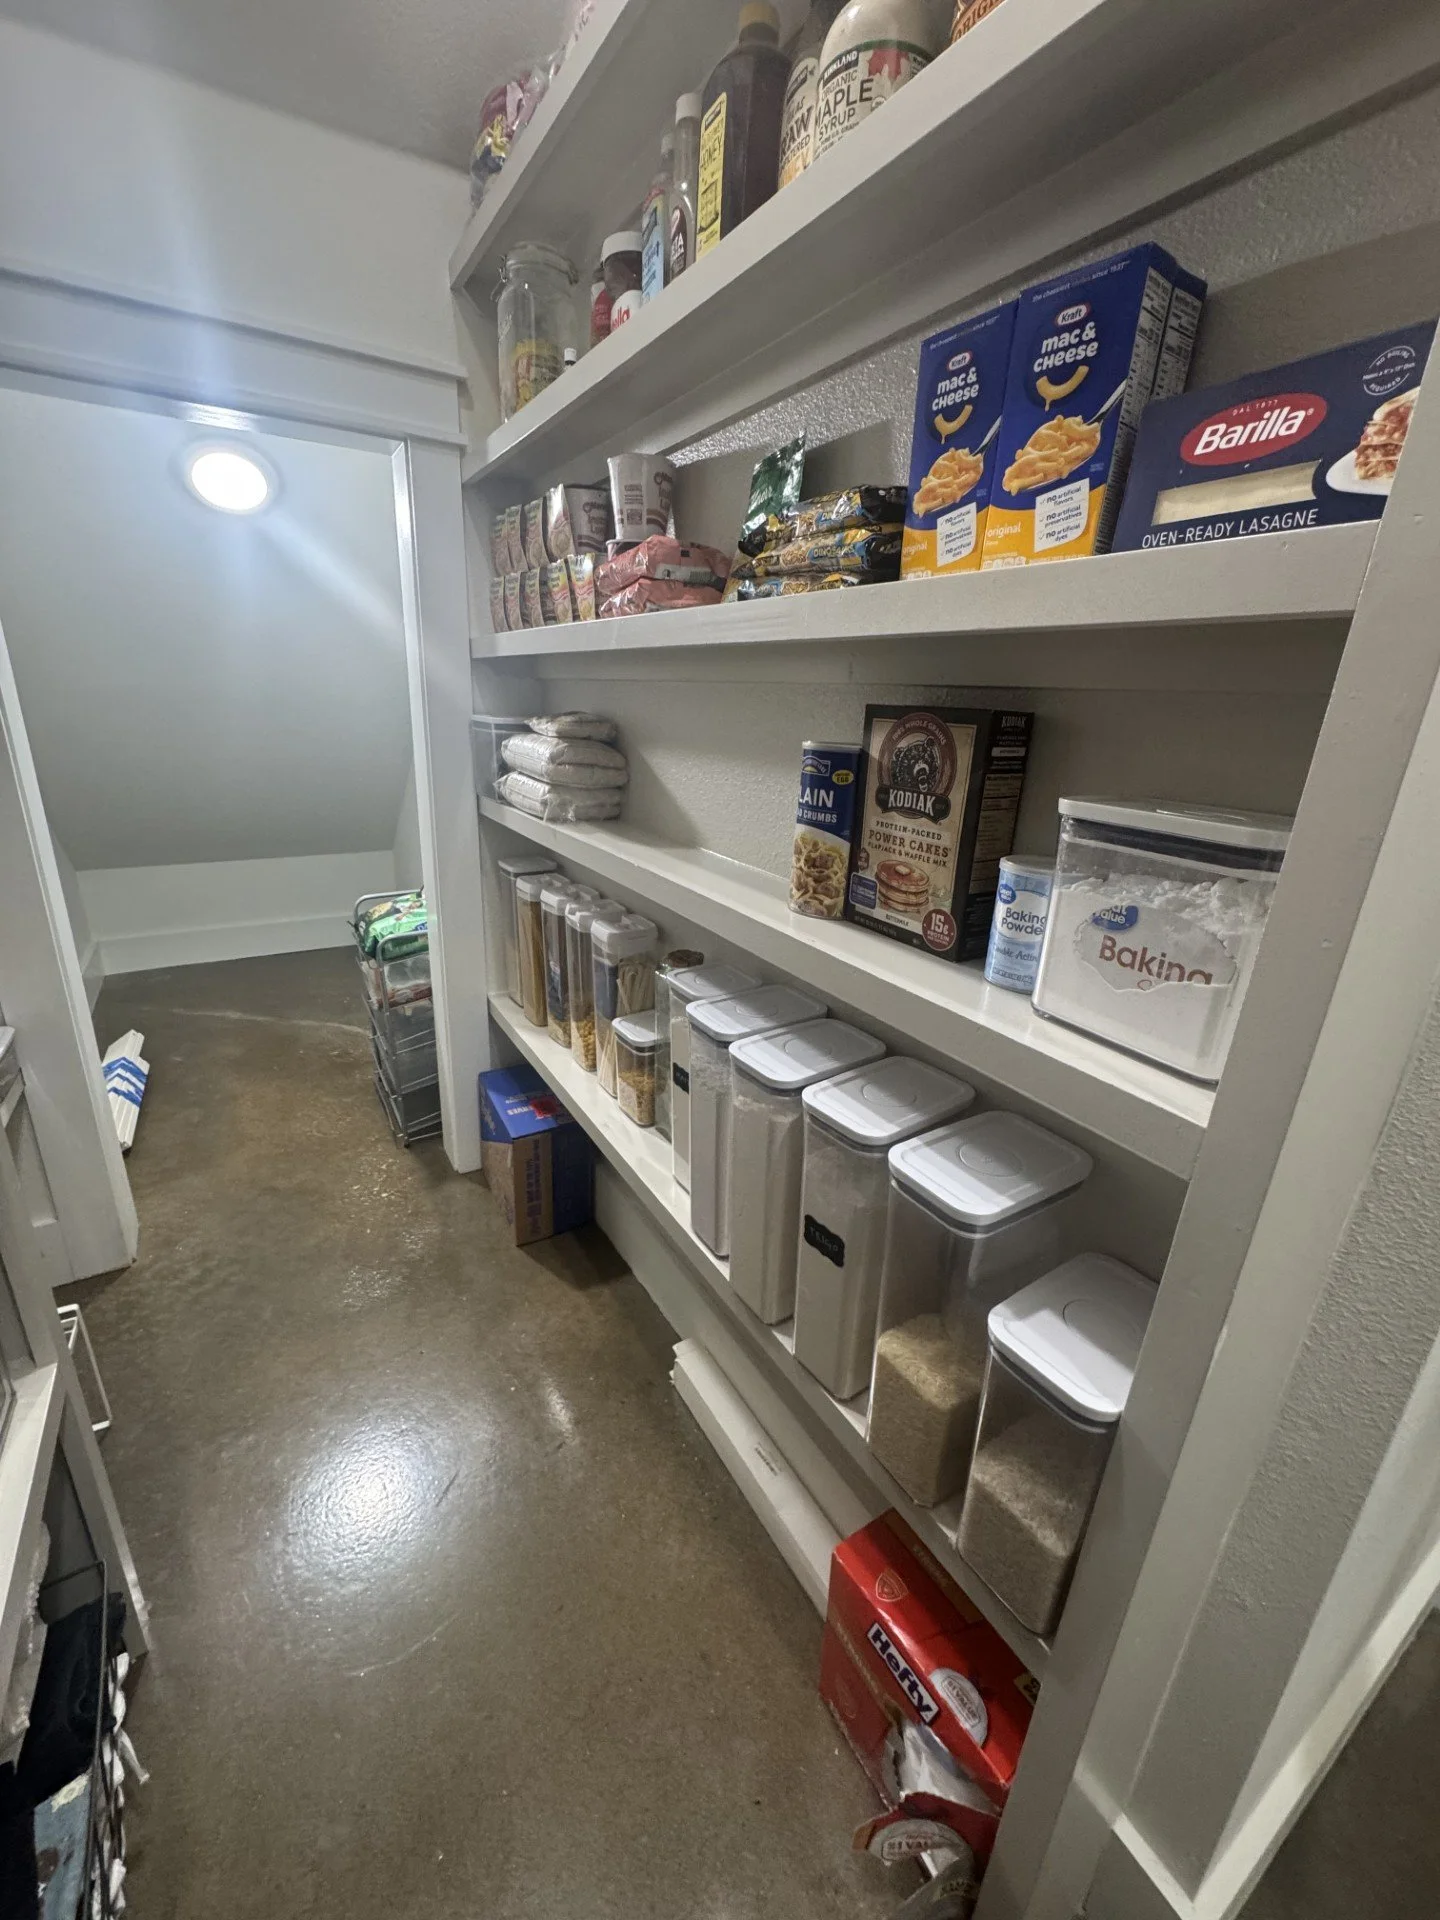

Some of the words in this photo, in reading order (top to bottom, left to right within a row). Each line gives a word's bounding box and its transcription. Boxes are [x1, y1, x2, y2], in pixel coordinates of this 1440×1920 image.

[823, 50, 860, 80] KIRKLAND
[821, 68, 859, 101] ORGANIC
[780, 105, 813, 157] RAW
[818, 107, 856, 141] SYRUP
[1061, 308, 1083, 323] Kraft
[1041, 328, 1081, 355] mac
[1081, 321, 1096, 341] &
[937, 373, 966, 395] mac
[966, 366, 978, 383] &
[1232, 405, 1251, 416] DAL
[1255, 399, 1279, 410] 1877
[1193, 405, 1306, 456] Barilla
[1046, 494, 1057, 503] no
[1057, 486, 1082, 500] artificial
[1053, 496, 1074, 506] flavors
[1044, 511, 1082, 528] preservatives
[1046, 512, 1057, 521] no
[1057, 504, 1081, 518] artificial
[987, 521, 1022, 538] original
[1045, 530, 1056, 539] no
[1056, 523, 1081, 535] artificial
[1142, 521, 1235, 549] OVEN-READY
[1238, 508, 1319, 535] LASAGNE
[798, 785, 834, 808] LAIN
[888, 788, 936, 817] KODIAK
[803, 809, 838, 823] CRUMBS
[875, 820, 943, 840] PROTEIN-PACKED
[867, 842, 897, 854] FLAPJACK
[904, 851, 931, 864] WAFFLE
[932, 858, 948, 867] MIX
[868, 829, 906, 849] POWER
[909, 840, 949, 858] CAKES
[1001, 917, 1046, 936] Powde
[871, 1628, 934, 1713] Hefty
